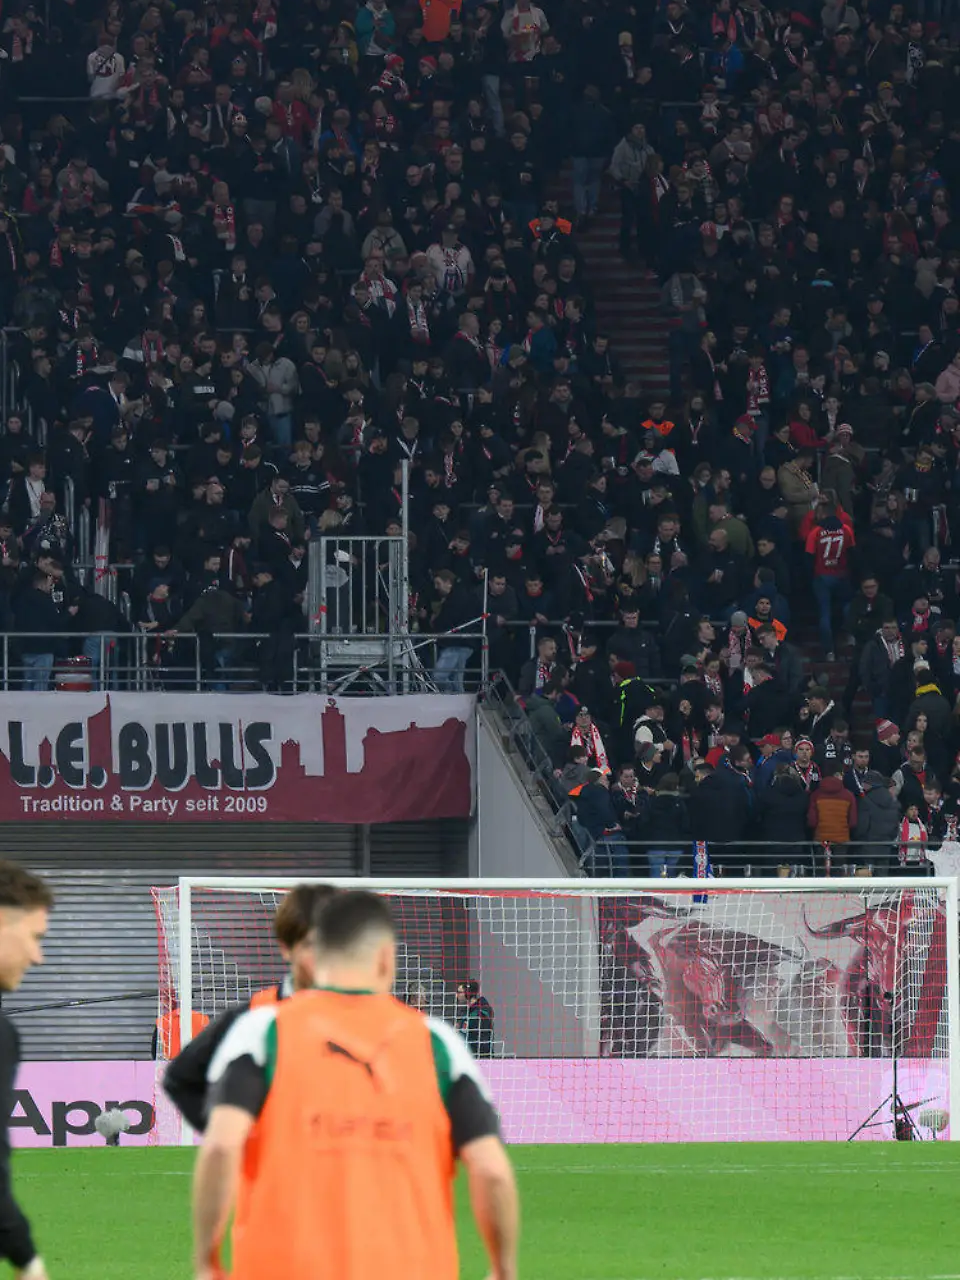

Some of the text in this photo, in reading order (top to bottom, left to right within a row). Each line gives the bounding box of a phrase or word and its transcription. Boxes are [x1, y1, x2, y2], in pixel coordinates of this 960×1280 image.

[820, 535, 844, 559] 77
[118, 721, 278, 791] BULLS
[20, 795, 268, 816] Tradition & Party seit 2009
[7, 1088, 156, 1147] App
